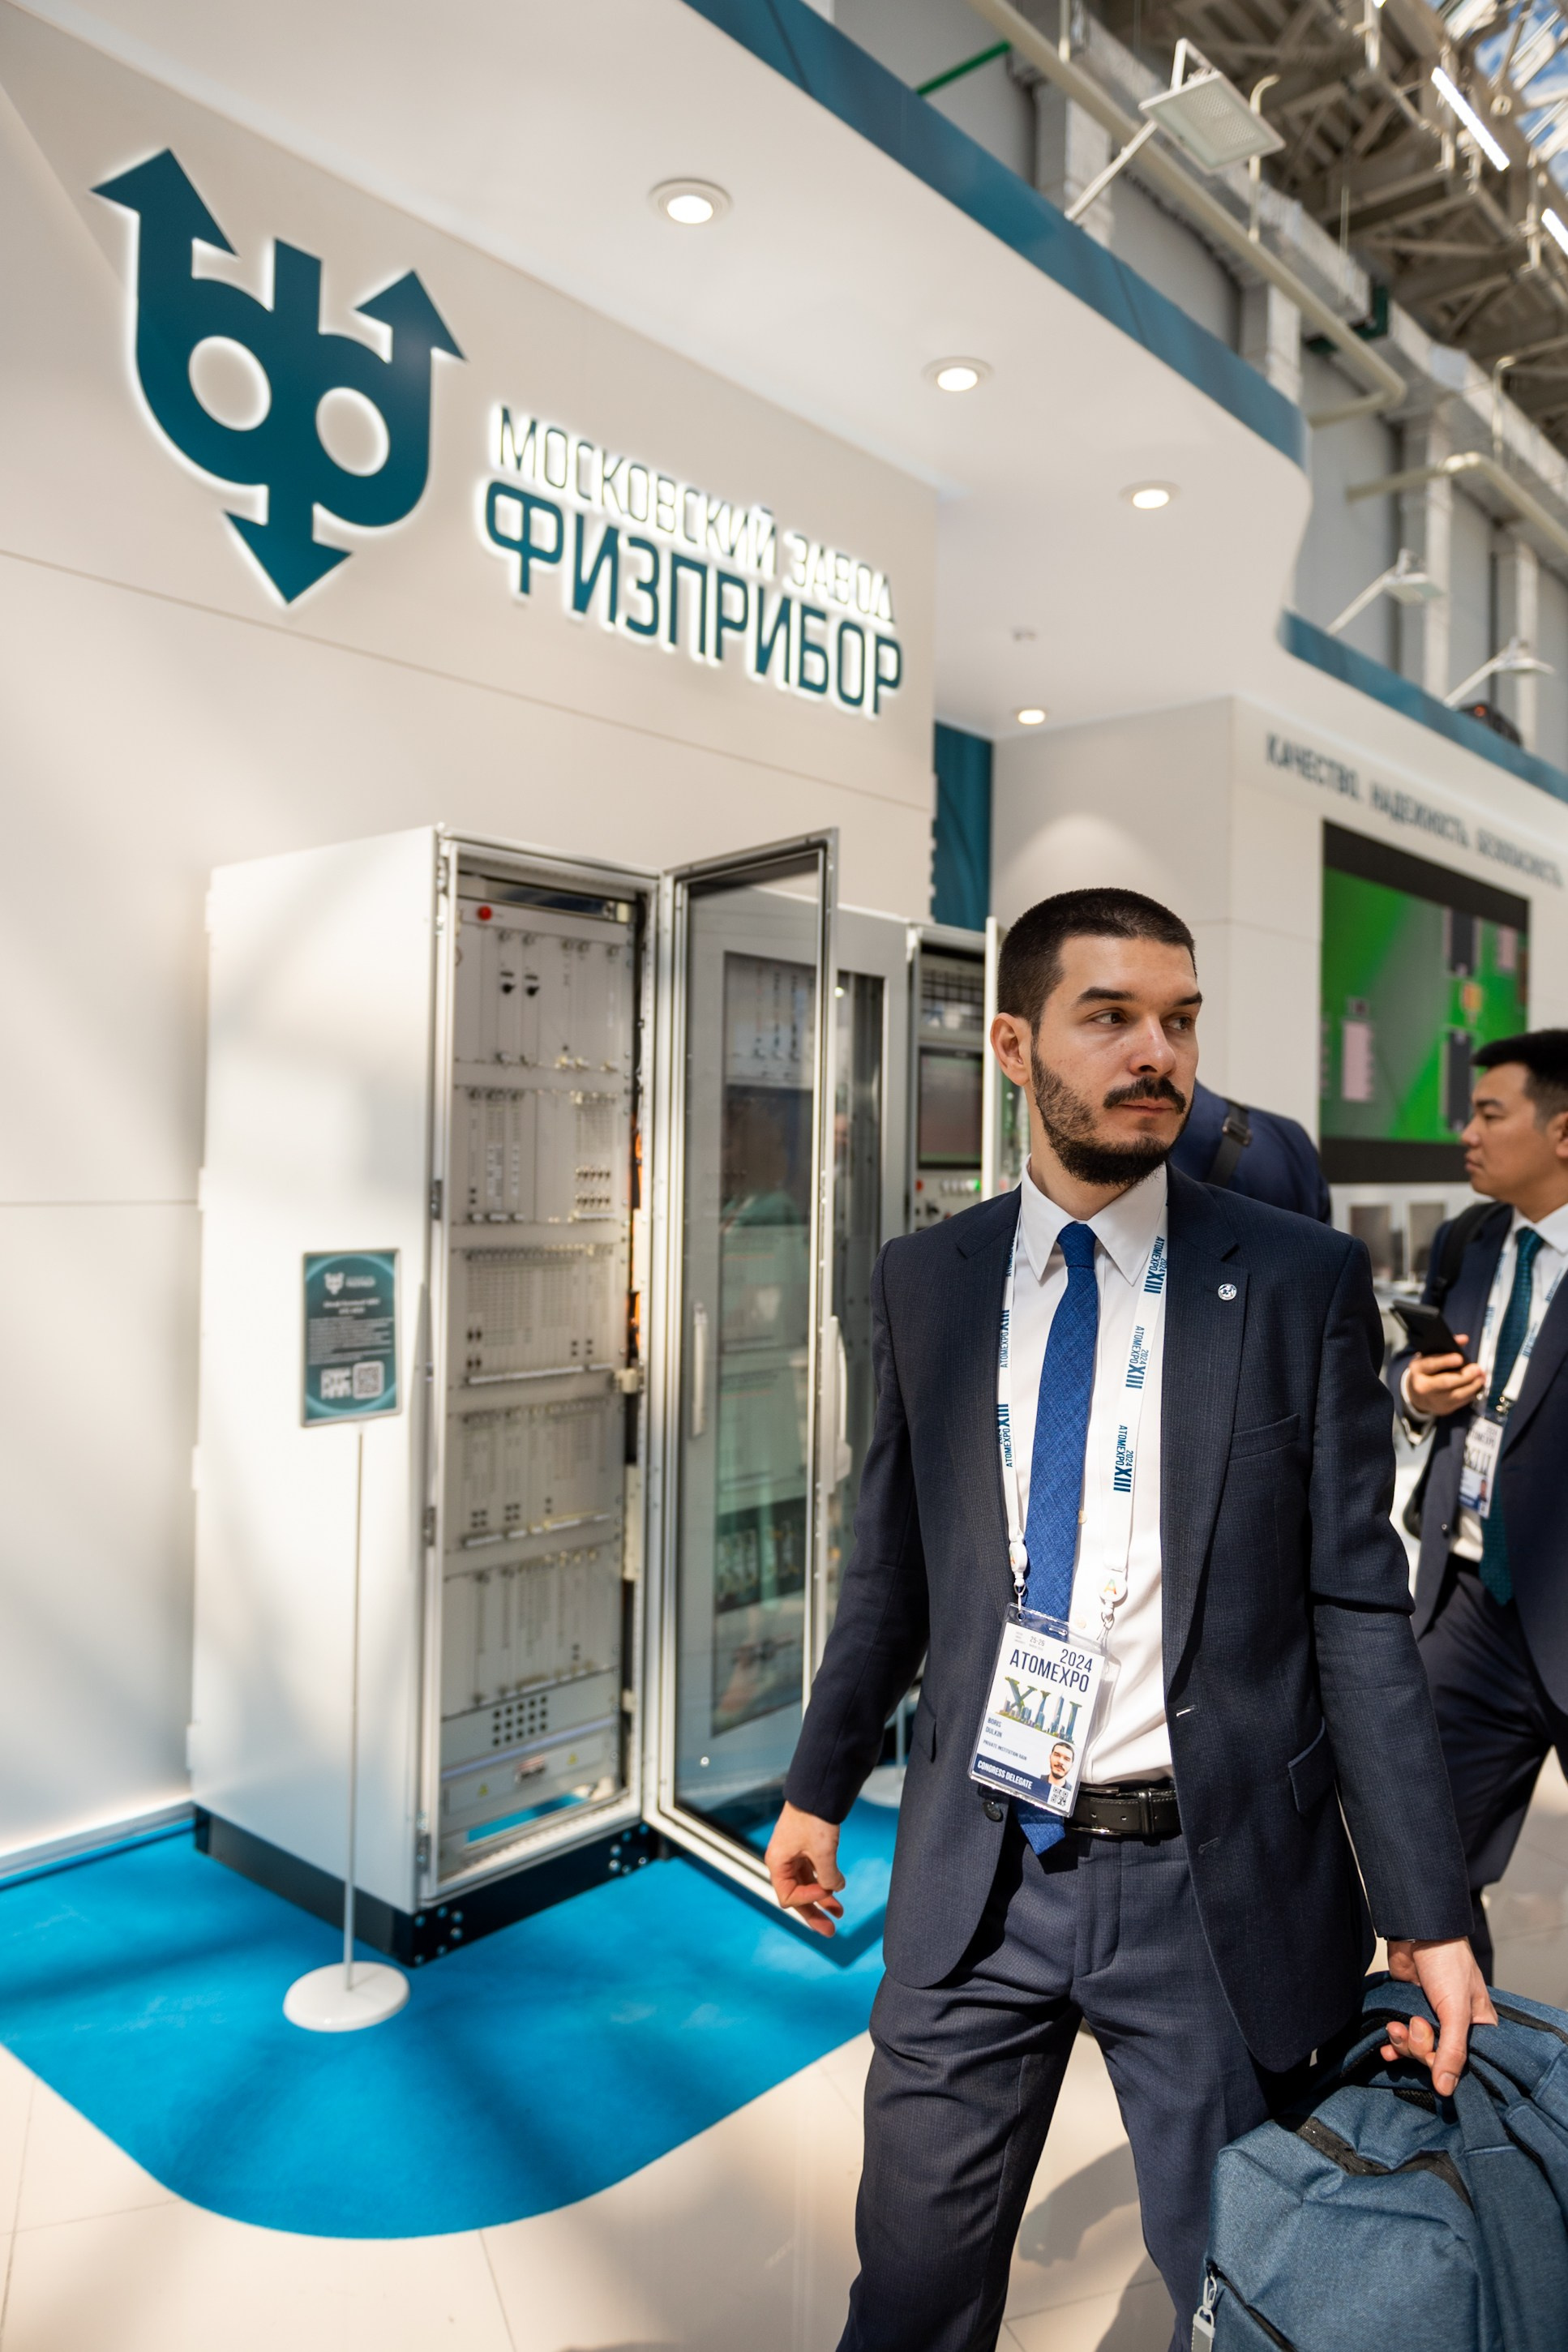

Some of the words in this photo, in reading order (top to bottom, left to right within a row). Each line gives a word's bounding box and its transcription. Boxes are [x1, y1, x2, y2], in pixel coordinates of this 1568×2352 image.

[493, 405, 777, 579] МОСКОВСКИЙ
[783, 531, 895, 626] ЗАВОД
[486, 480, 902, 714] ФИЗПРИБОР
[1149, 1236, 1165, 1271] ATOMEXPO
[1159, 1258, 1167, 1272] 2024
[1144, 1270, 1166, 1294] XIII
[1000, 1331, 1009, 1368] ATOMEXPO
[1129, 1326, 1145, 1364] ATOMEXPO
[1139, 1349, 1149, 1365] 2024
[1125, 1363, 1146, 1390] XIII
[998, 1403, 1010, 1428] XIII
[1002, 1429, 1013, 1467] ATOMEXPO
[1116, 1424, 1128, 1466] ATOMEXPO
[1125, 1450, 1134, 1467] 2024
[1113, 1466, 1133, 1493] XIII
[1009, 1649, 1090, 1692] ATOMEXPO
[1060, 1648, 1093, 1673] 2024
[987, 1717, 1001, 1728] BORIS
[983, 1739, 997, 1748] PRIVATE
[998, 1746, 1018, 1758] INSTITUTION
[977, 1760, 1006, 1779] CONGRESS
[1005, 1771, 1033, 1790] DELEGATE
